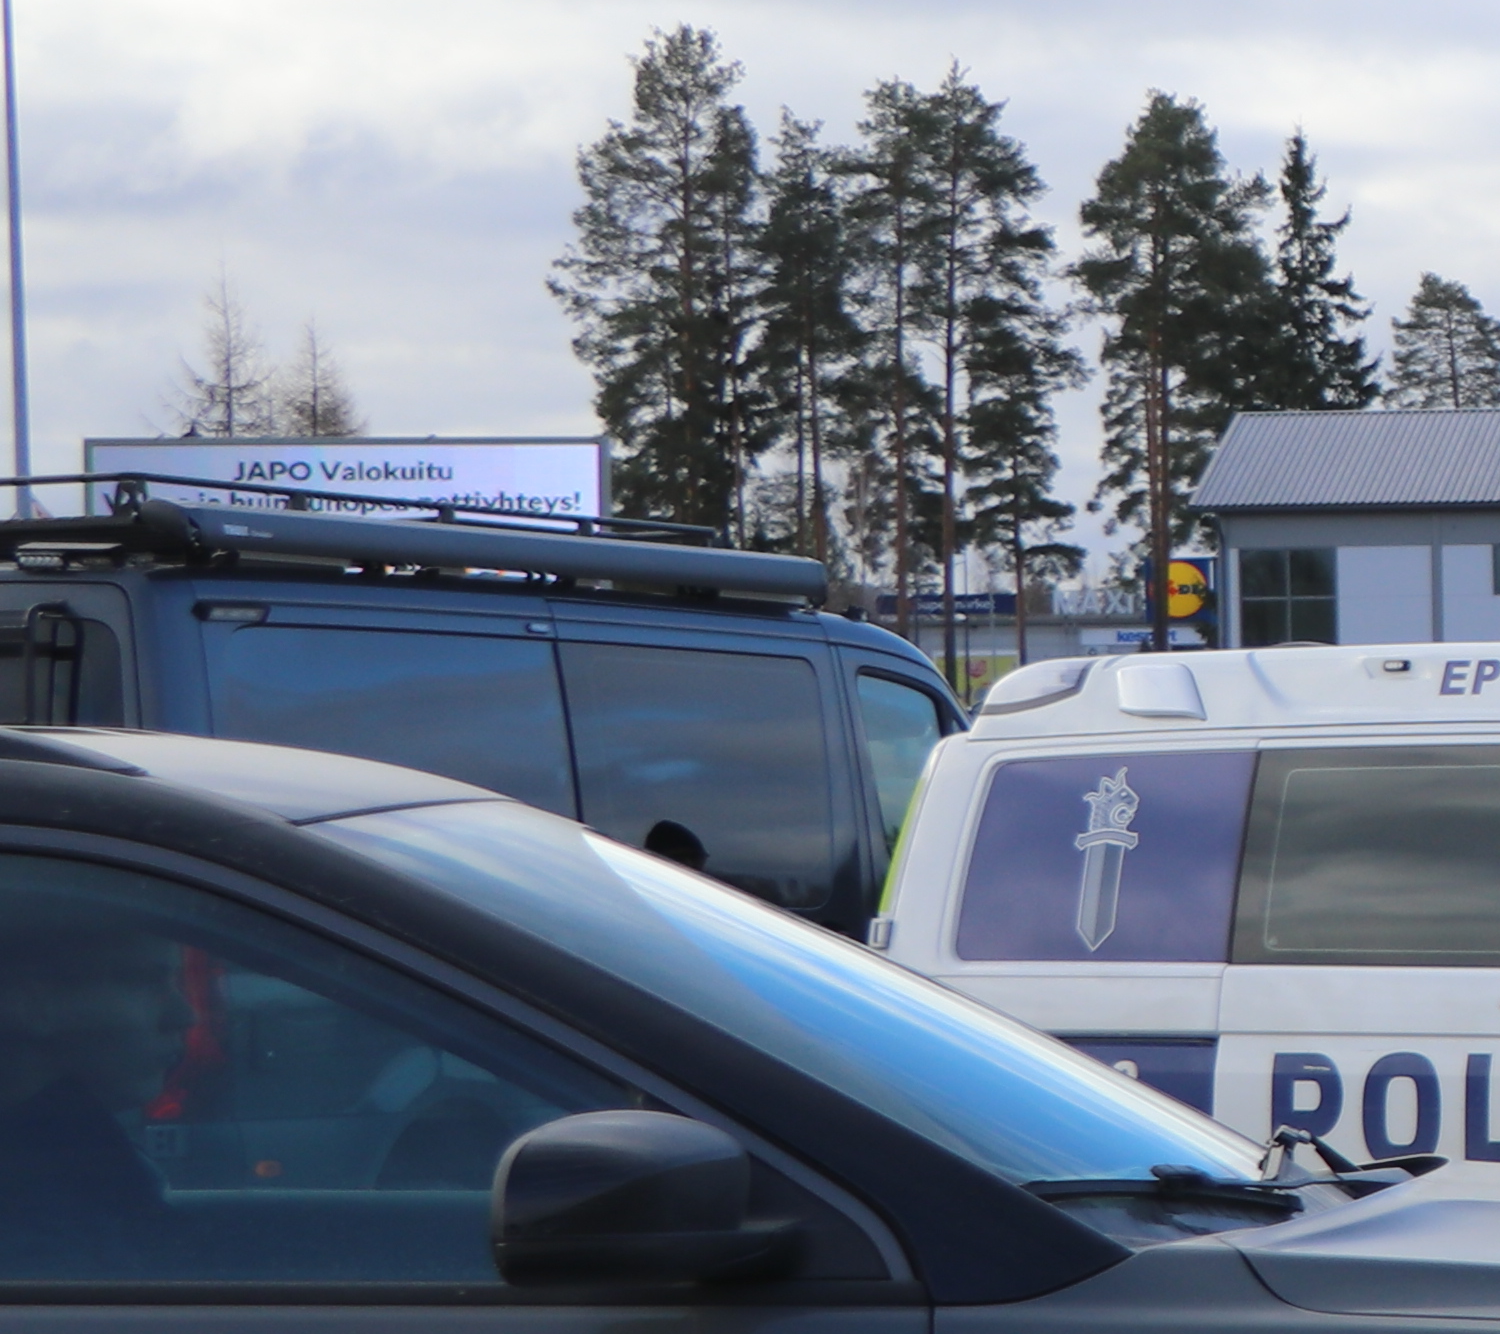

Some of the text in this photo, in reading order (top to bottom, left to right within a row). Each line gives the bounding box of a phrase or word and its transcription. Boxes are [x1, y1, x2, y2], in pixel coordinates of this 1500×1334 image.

[233, 461, 453, 481] JAPO Valokuitu
[1053, 588, 1134, 614] MAXI
